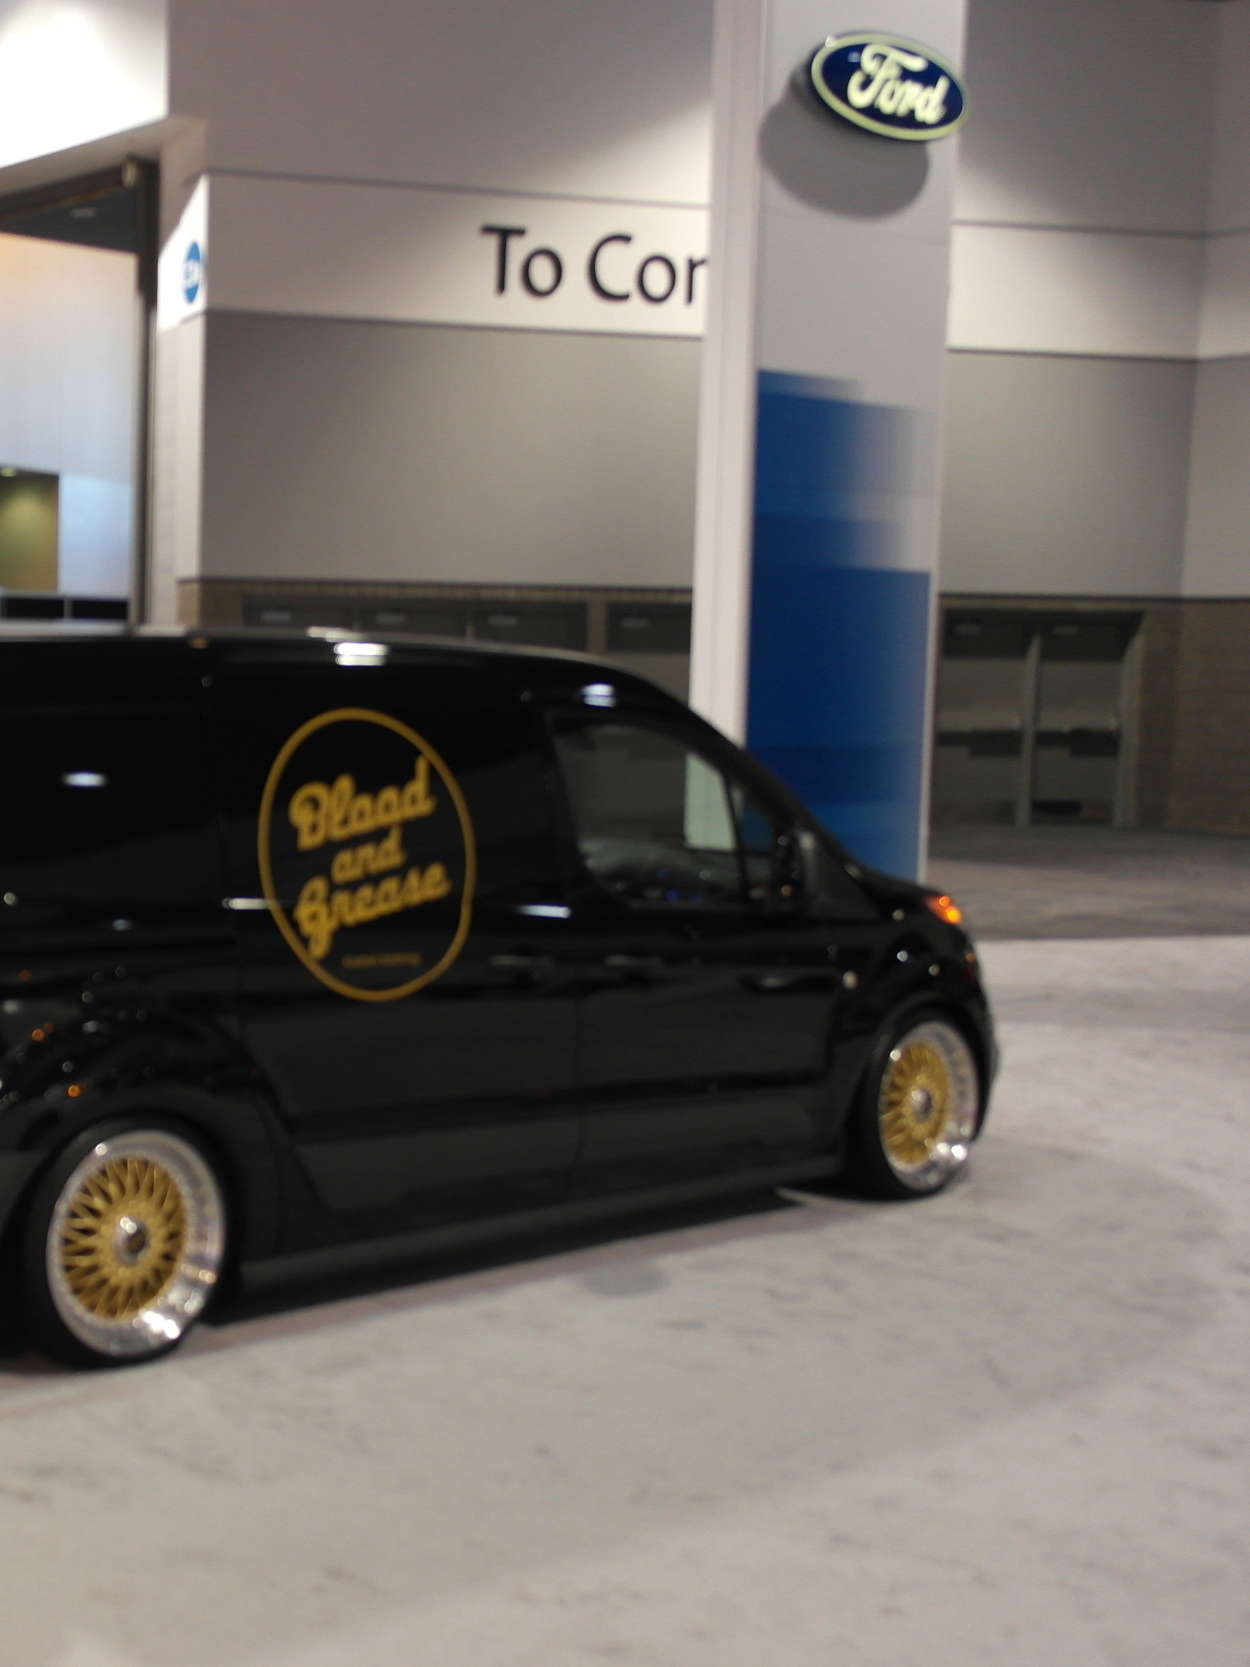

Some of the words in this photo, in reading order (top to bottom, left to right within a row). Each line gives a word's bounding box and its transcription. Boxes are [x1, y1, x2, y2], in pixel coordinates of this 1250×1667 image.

[847, 43, 950, 125] Ford
[480, 225, 563, 298] To
[289, 753, 436, 850] Blood
[331, 826, 407, 883] and
[294, 863, 451, 961] Grease
